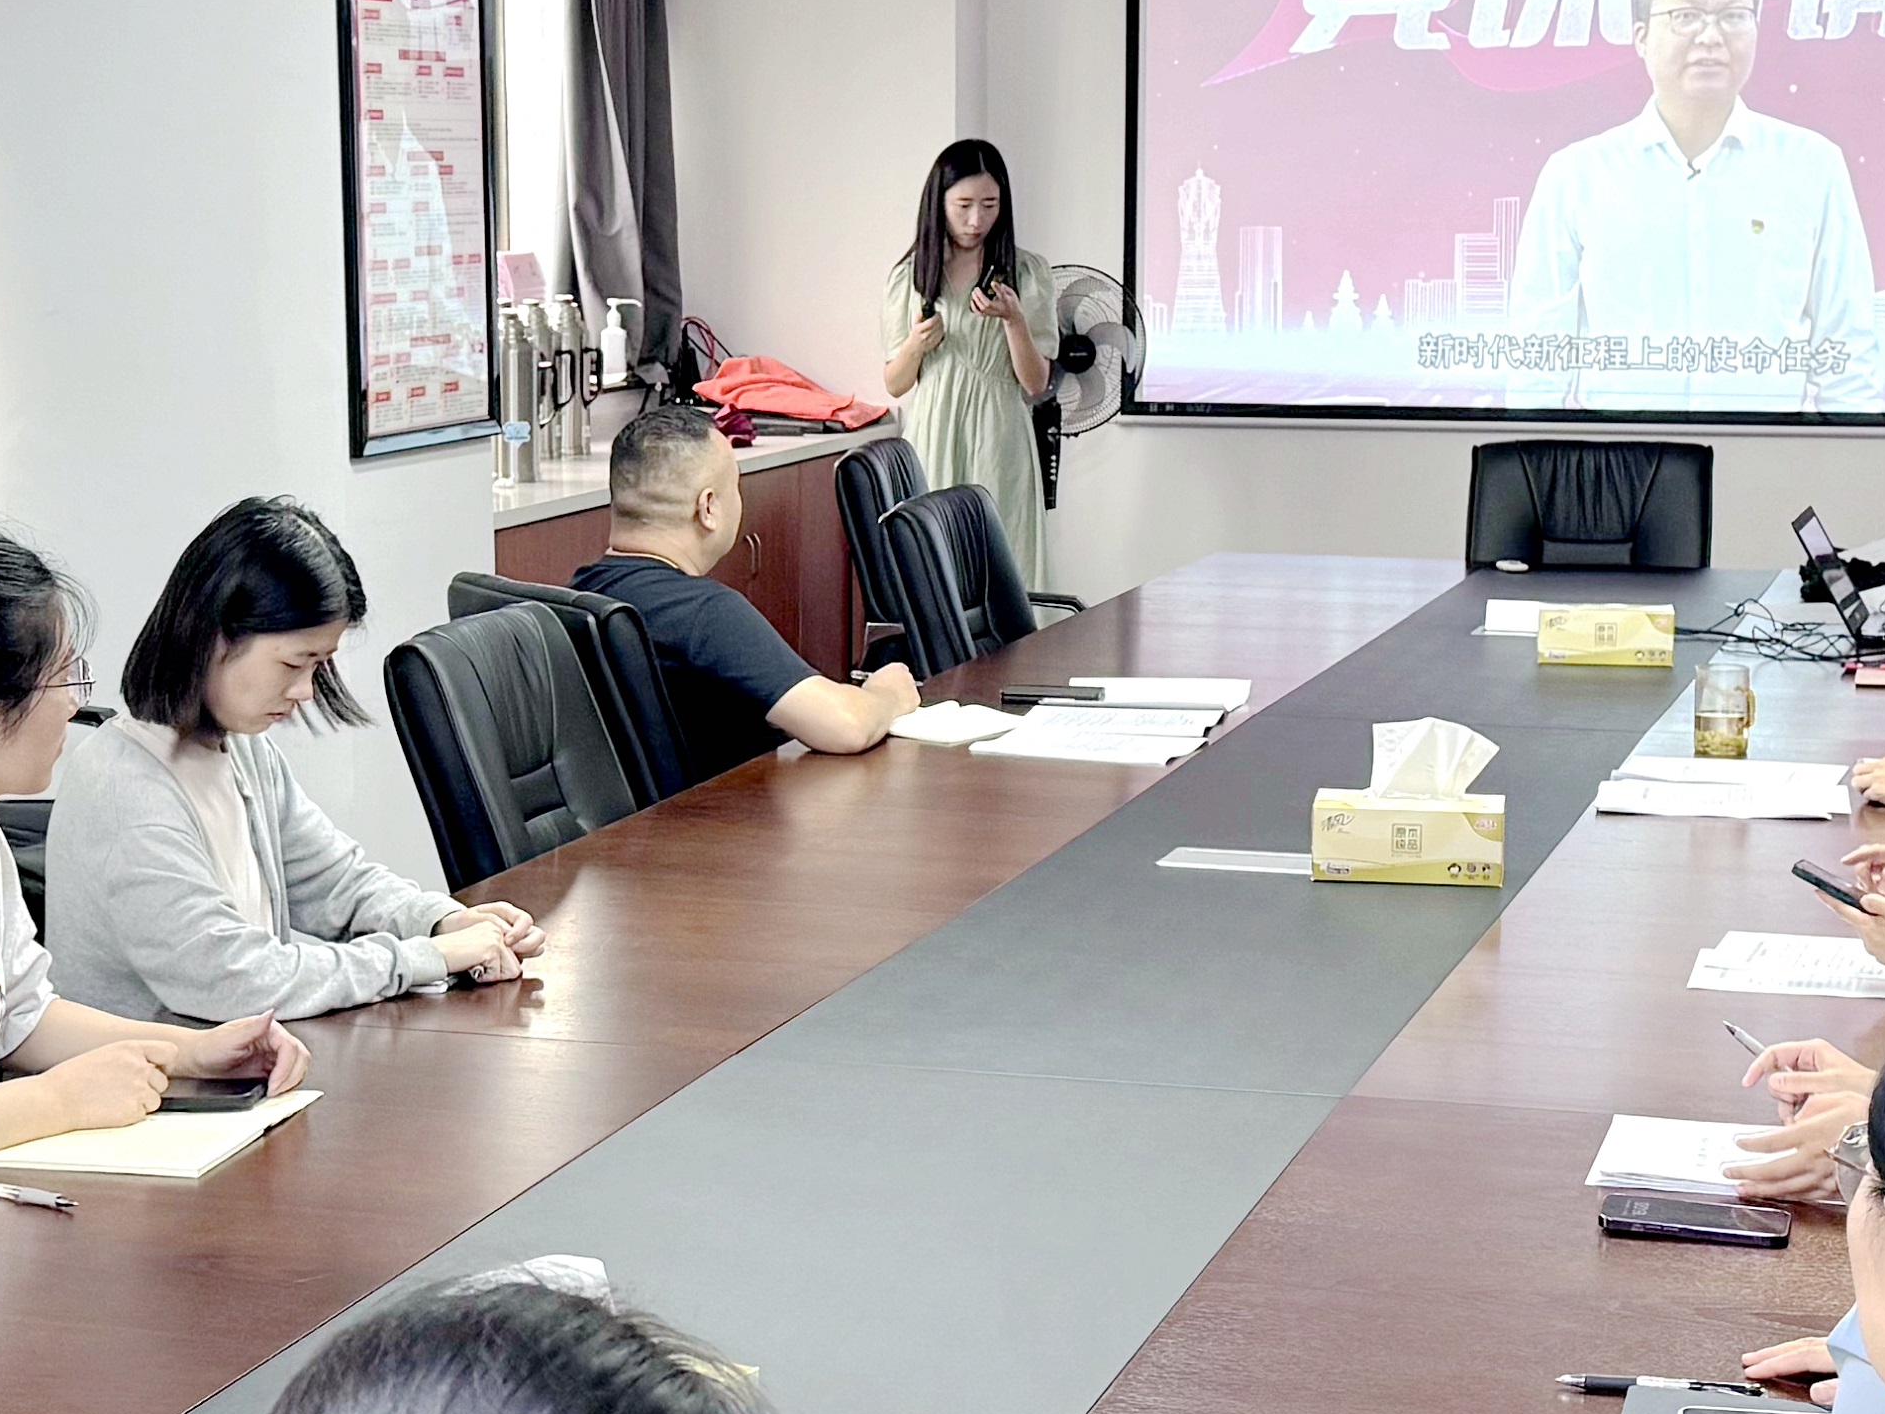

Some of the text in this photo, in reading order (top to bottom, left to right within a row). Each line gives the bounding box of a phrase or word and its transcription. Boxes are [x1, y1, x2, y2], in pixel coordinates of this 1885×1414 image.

[1418, 333, 1851, 375] 新时代新征程上的使命任务
